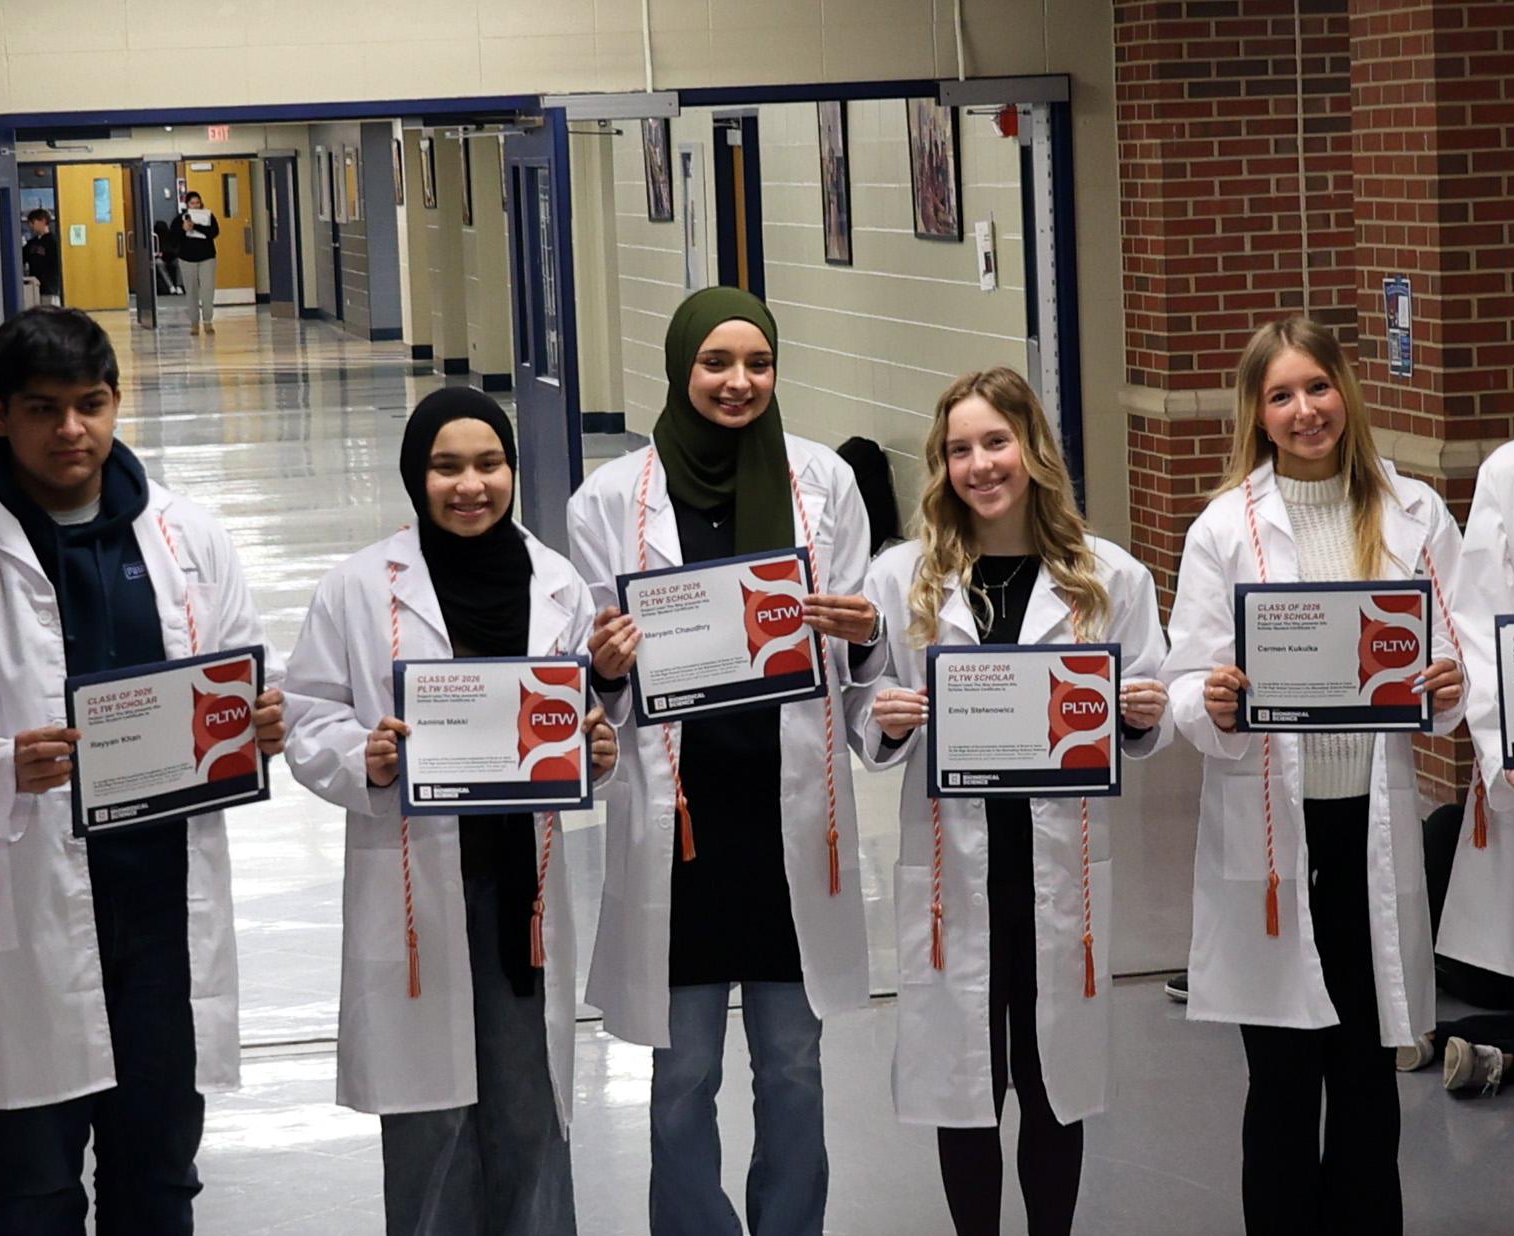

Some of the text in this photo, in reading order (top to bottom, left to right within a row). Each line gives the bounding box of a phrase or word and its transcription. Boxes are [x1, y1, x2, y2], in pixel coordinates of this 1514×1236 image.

[639, 582, 701, 598] CLASS OF 2026
[640, 591, 706, 607] PLTW SCHOLAR
[758, 606, 799, 623] PLTW
[1257, 613, 1281, 621] PLTW
[645, 630, 673, 638] Maryam
[1373, 640, 1416, 652] PLTW
[88, 694, 116, 705] CLASS
[119, 691, 131, 699] OF
[116, 696, 157, 710] SCHOLAR
[1062, 702, 1105, 714] PLTW
[205, 706, 249, 726] PLTW
[532, 713, 575, 725] PLTW
